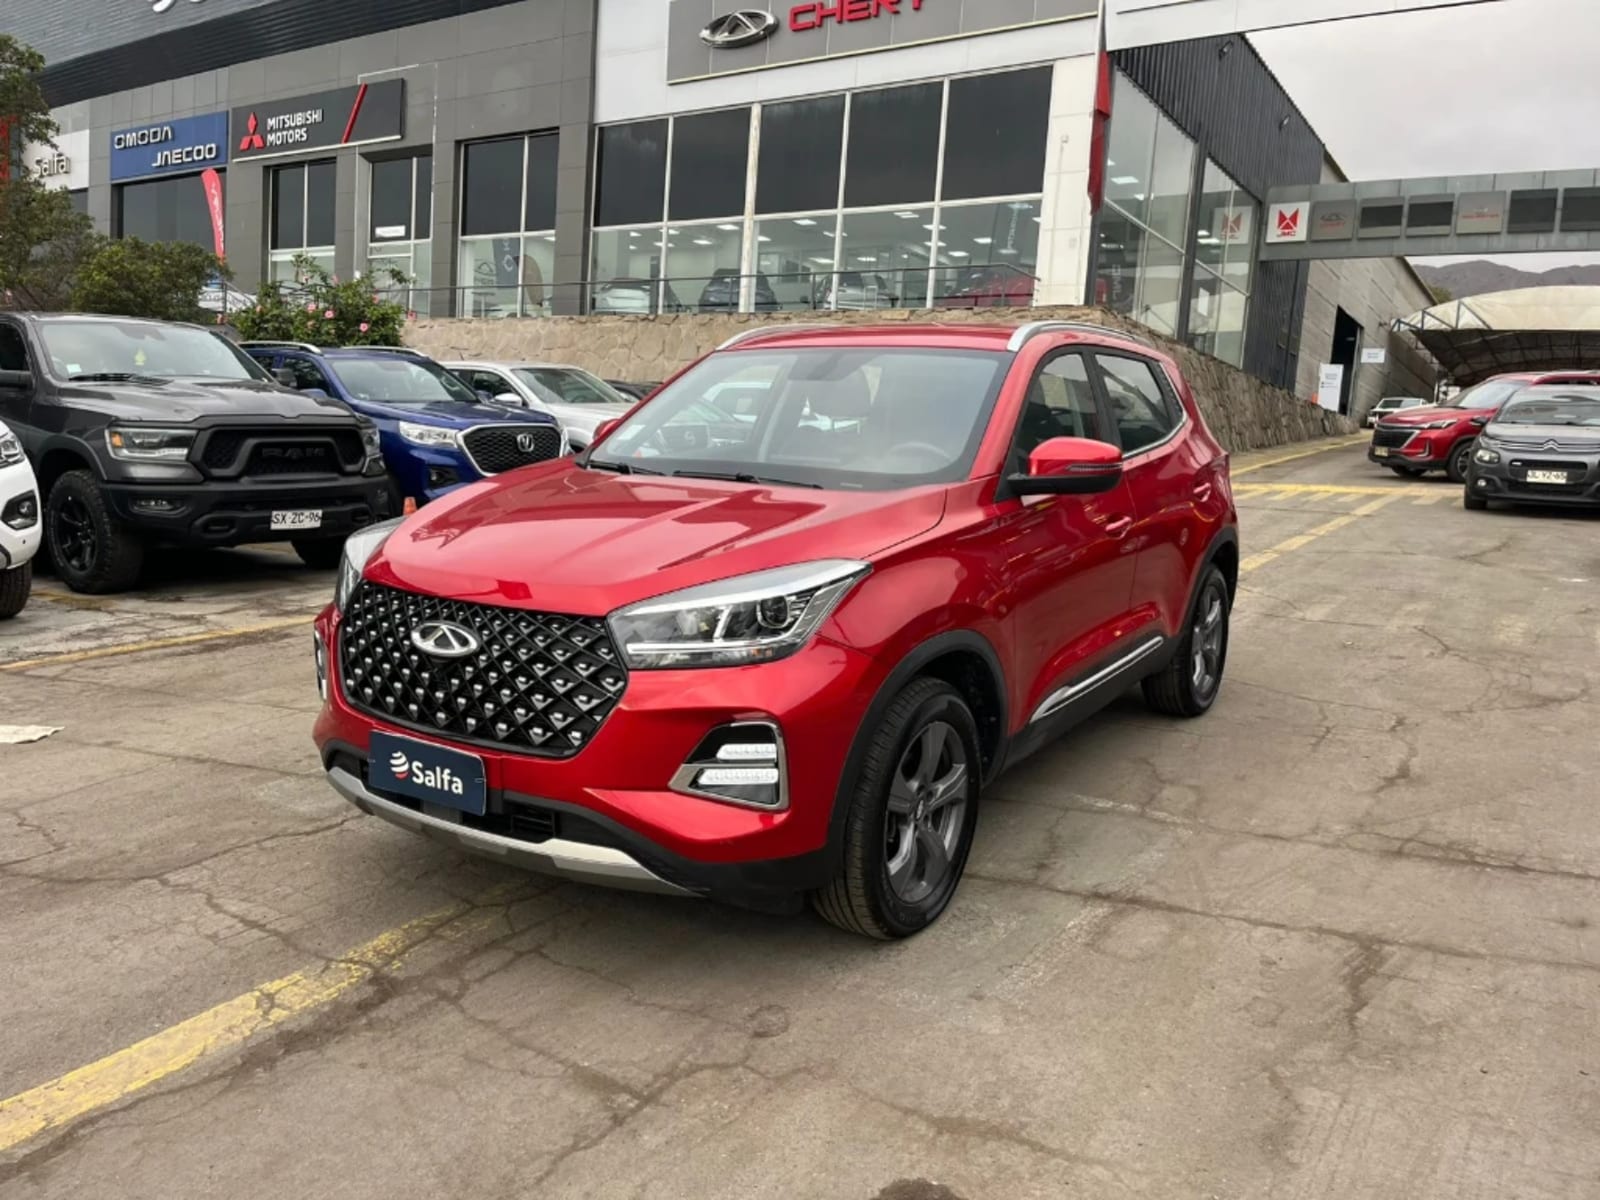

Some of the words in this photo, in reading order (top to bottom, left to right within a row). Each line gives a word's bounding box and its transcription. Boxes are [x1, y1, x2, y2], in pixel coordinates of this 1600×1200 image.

[266, 108, 323, 131] MITSUBISHI
[114, 126, 172, 149] OMODA
[266, 127, 308, 147] MOTORS
[151, 143, 217, 167] JAECOO
[411, 760, 464, 795] Salfa
